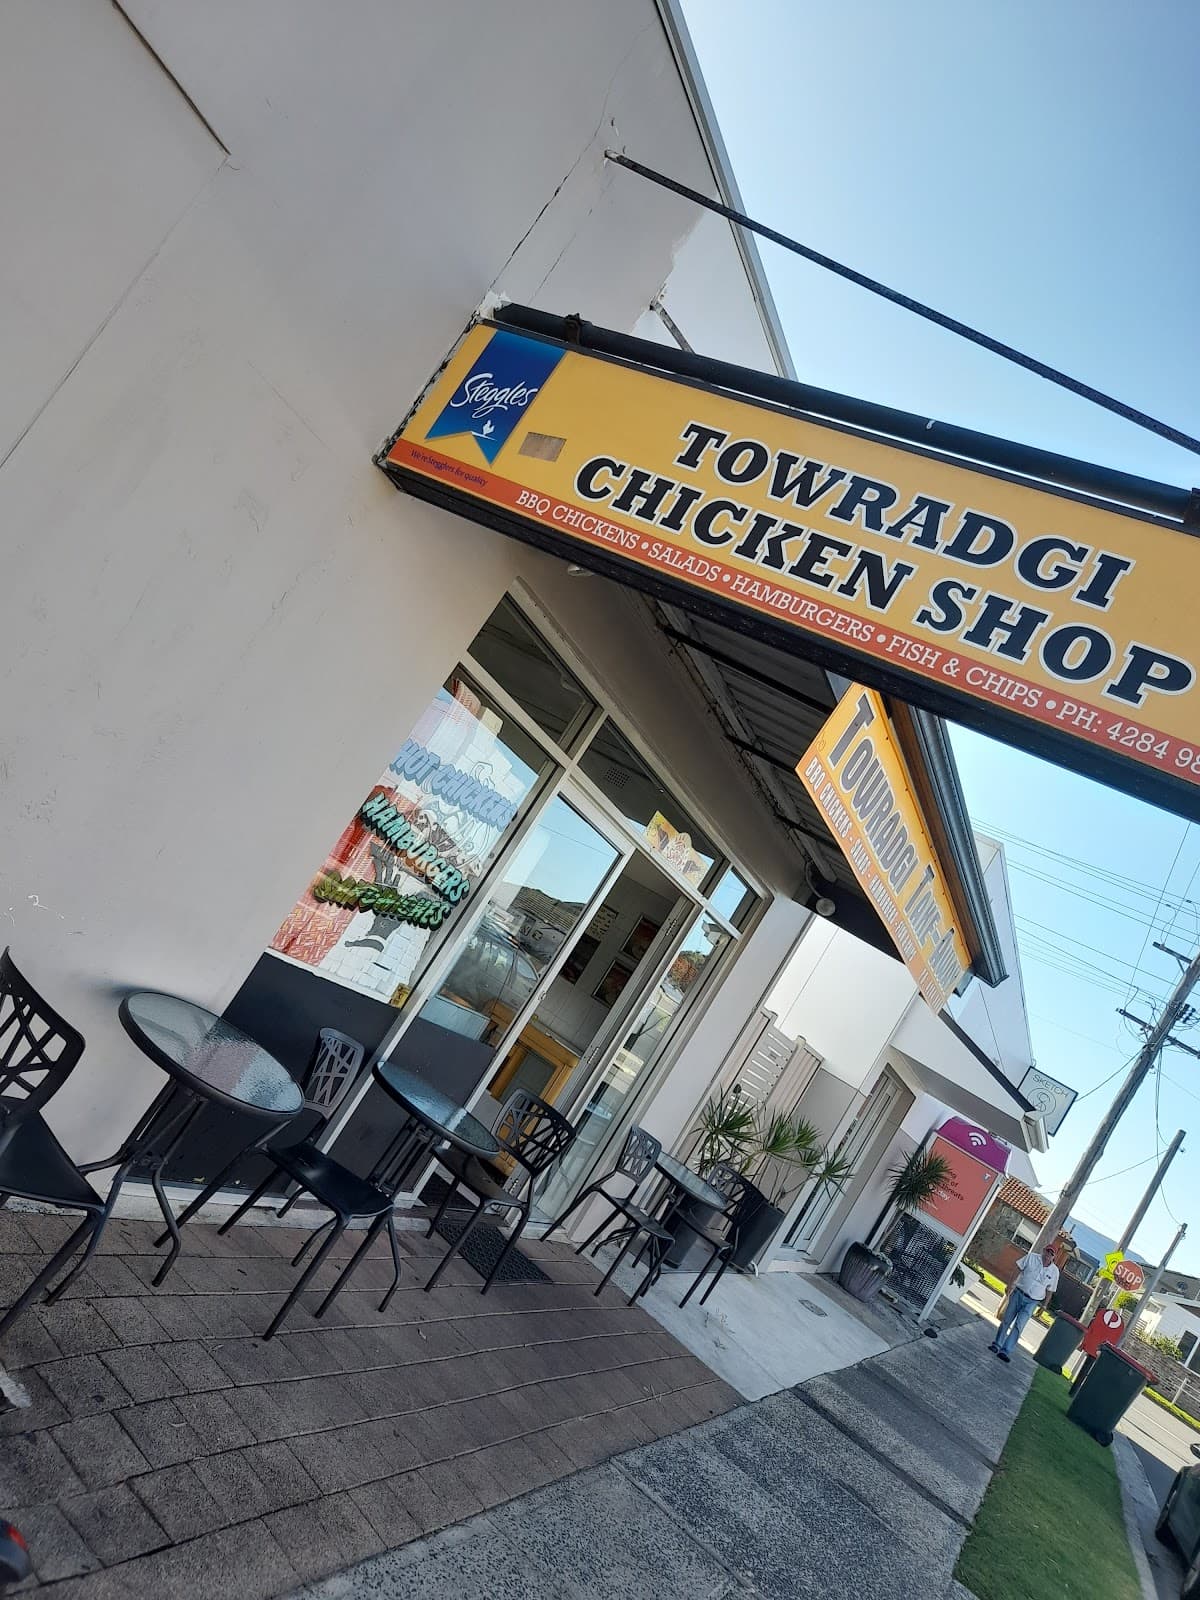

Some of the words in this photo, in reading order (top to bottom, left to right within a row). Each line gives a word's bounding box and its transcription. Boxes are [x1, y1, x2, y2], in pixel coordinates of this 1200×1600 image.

[449, 372, 538, 418] Steggles
[675, 421, 1134, 610] TOWRADGI
[515, 489, 553, 517] BBQ
[552, 505, 641, 550] CHICKENS
[647, 543, 723, 583] SALADS
[729, 573, 876, 645] HAMBURGERS
[885, 634, 944, 669] FISH
[942, 658, 961, 677] &
[965, 666, 1043, 709] CHIPS
[1056, 700, 1102, 733] PH:
[1106, 721, 1170, 760] 4284
[575, 457, 917, 612] CHICKEN
[912, 577, 1195, 709] SHOP
[390, 739, 441, 786] HOT
[430, 764, 518, 832] CHICKENS
[804, 756, 826, 789] BBQ
[819, 781, 852, 839] CHICKENS
[827, 690, 918, 896] TOWRADGI
[361, 791, 470, 903] HAMBURGERS
[1032, 1074, 1070, 1098] SKETCH
[1115, 1264, 1142, 1286] STOP
